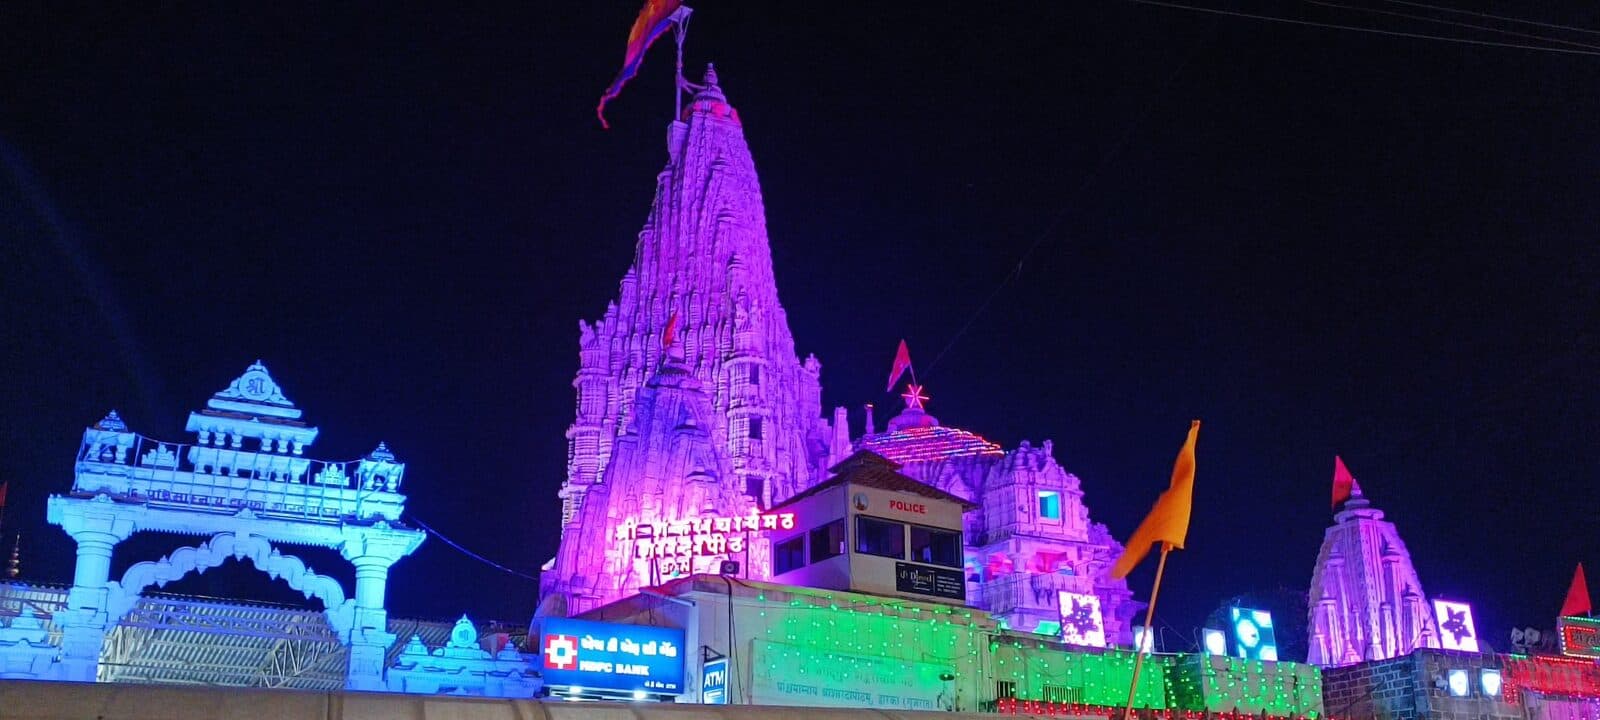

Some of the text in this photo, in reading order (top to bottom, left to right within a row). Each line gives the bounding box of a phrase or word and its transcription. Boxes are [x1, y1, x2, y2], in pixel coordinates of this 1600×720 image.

[889, 500, 926, 514] POLICE
[615, 663, 650, 676] BANK
[703, 670, 725, 689] ATM
